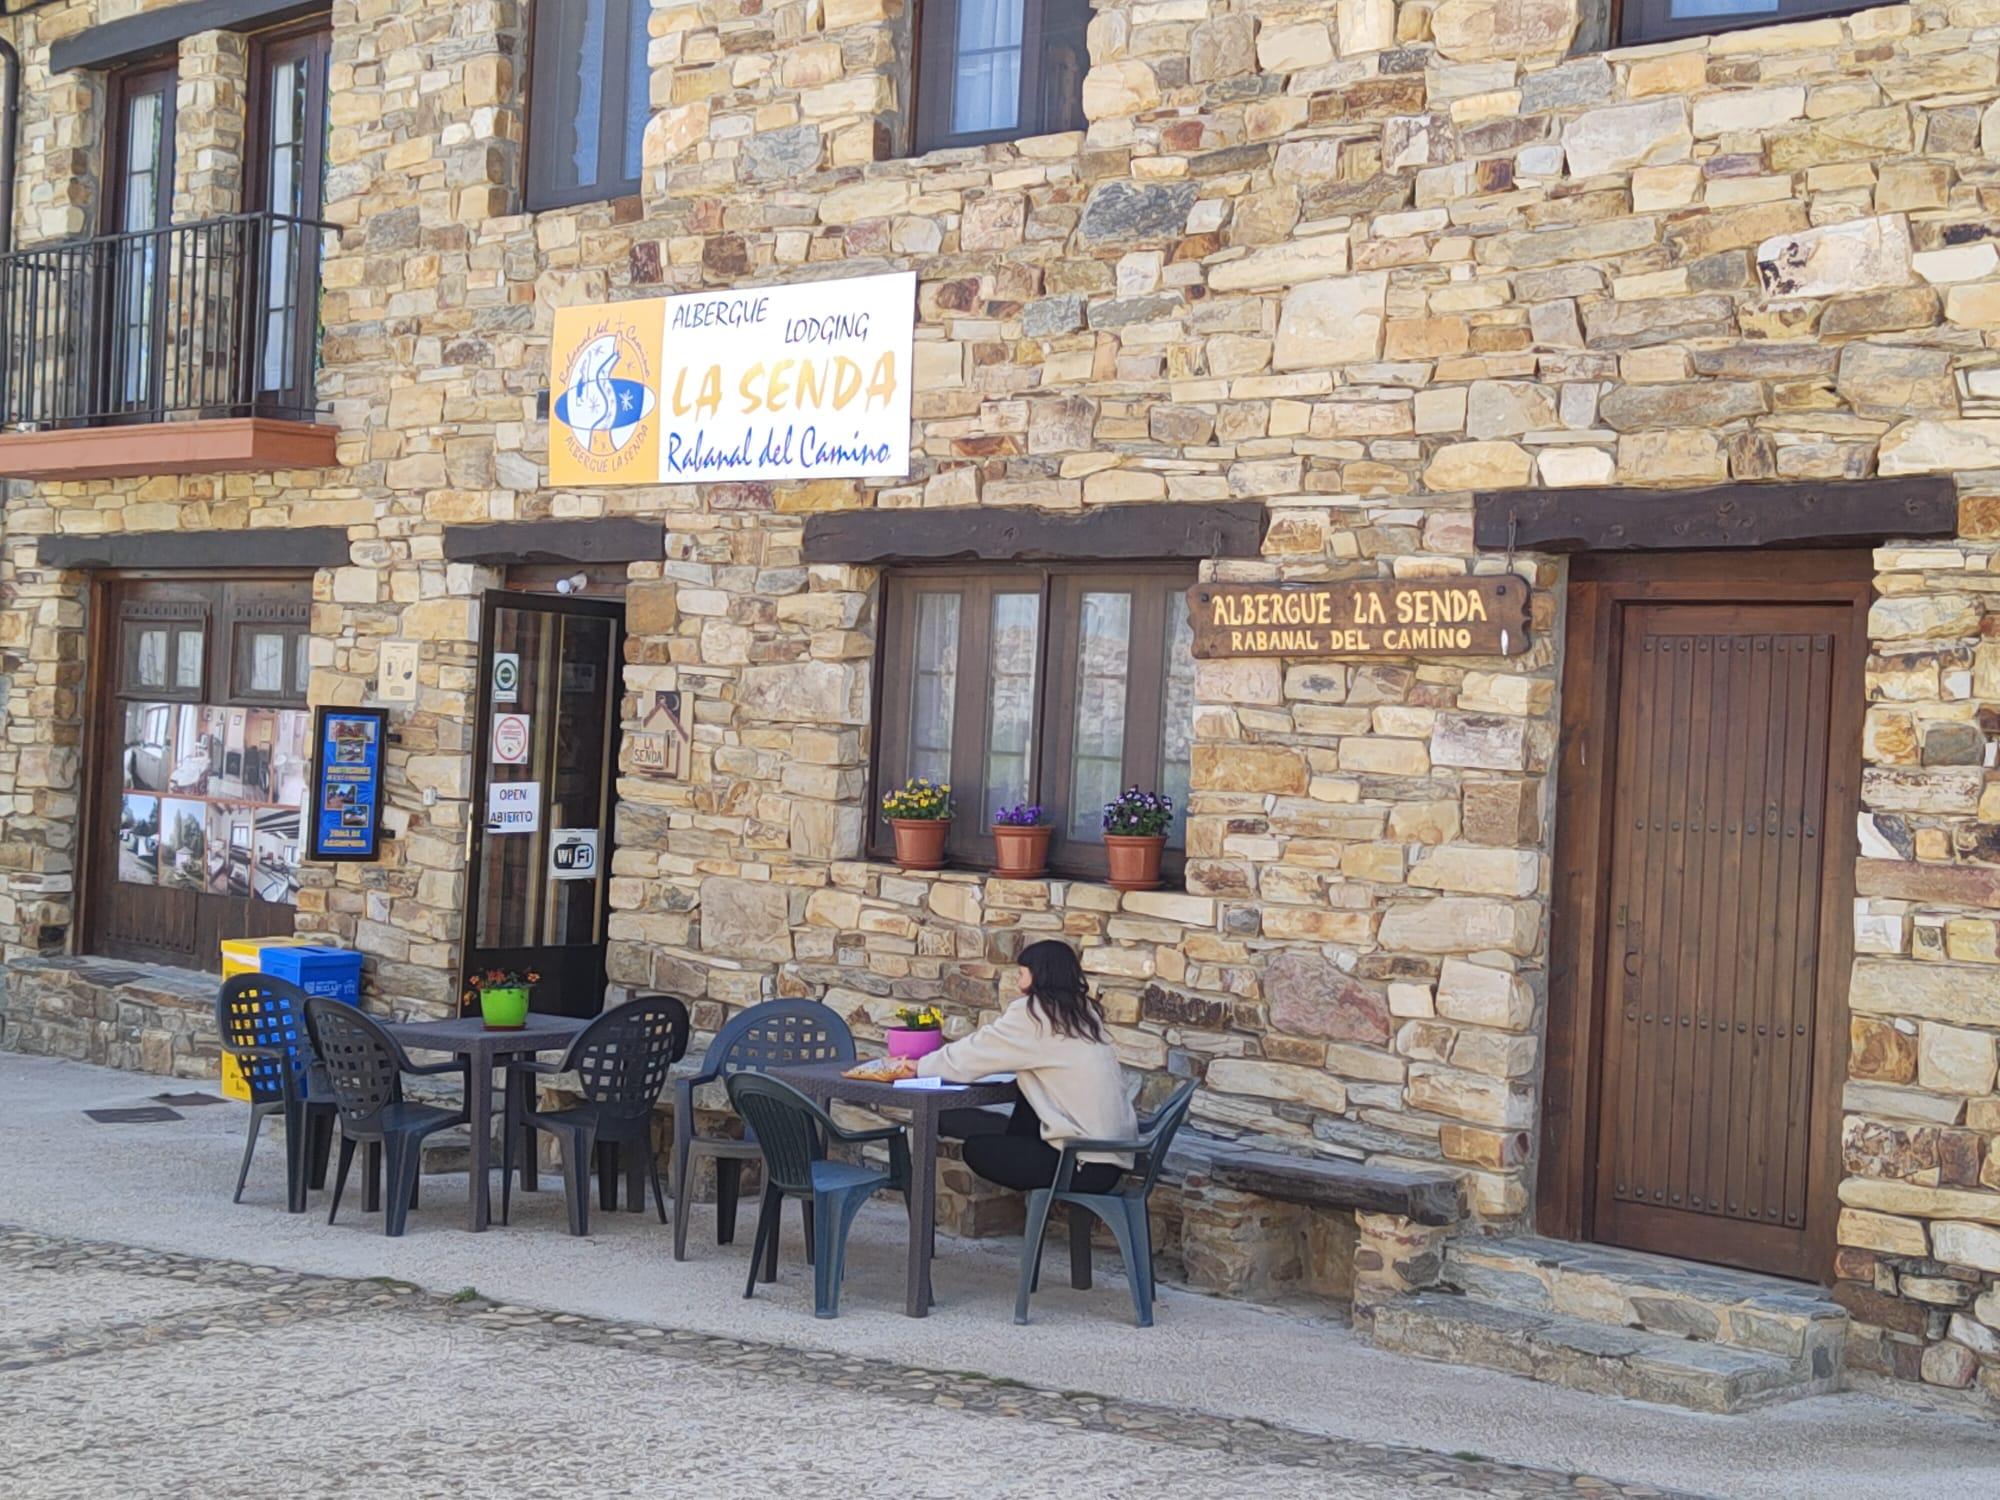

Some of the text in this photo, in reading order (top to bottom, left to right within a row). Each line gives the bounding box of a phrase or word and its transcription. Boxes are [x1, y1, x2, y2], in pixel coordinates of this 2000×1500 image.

[672, 297, 769, 330] ALBERGUE
[784, 312, 870, 344] LODGING
[672, 350, 898, 423] LA SENDA
[565, 424, 649, 473] ALBERGUE LA SENDA
[668, 426, 752, 474] Rabanal
[758, 424, 793, 468] del
[1213, 589, 1488, 625] ALBERGUE LA SENDA
[1231, 629, 1319, 651] RABANAL
[1330, 630, 1370, 650] DEL
[634, 749, 663, 764] SENDA
[500, 788, 527, 801] OPEN
[490, 811, 533, 823] ABIERTO
